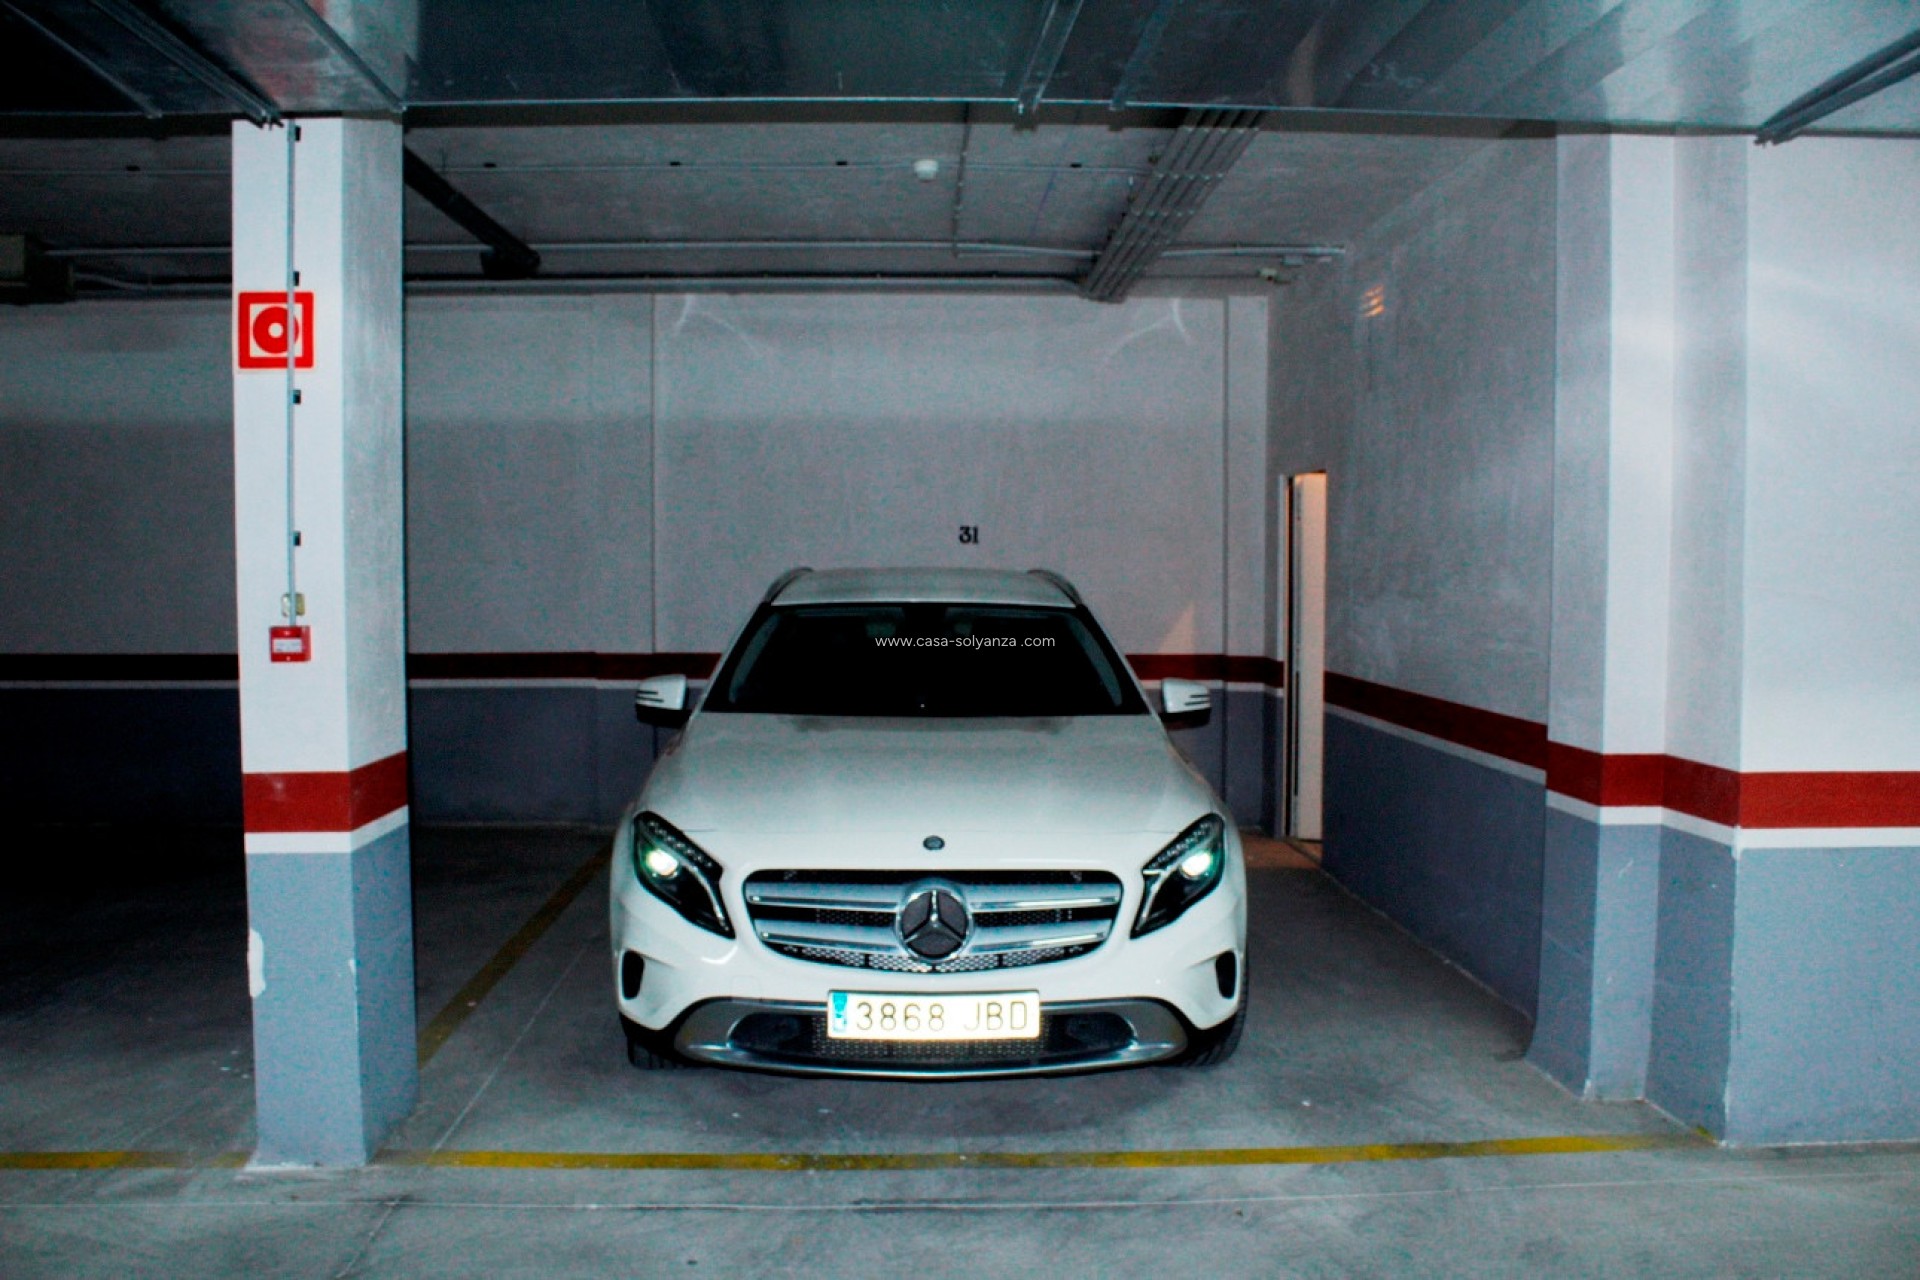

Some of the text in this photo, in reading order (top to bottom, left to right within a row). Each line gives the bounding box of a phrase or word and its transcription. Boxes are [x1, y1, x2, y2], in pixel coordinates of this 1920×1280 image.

[959, 525, 979, 545] 31
[856, 1001, 1028, 1032] 3868 JBD
